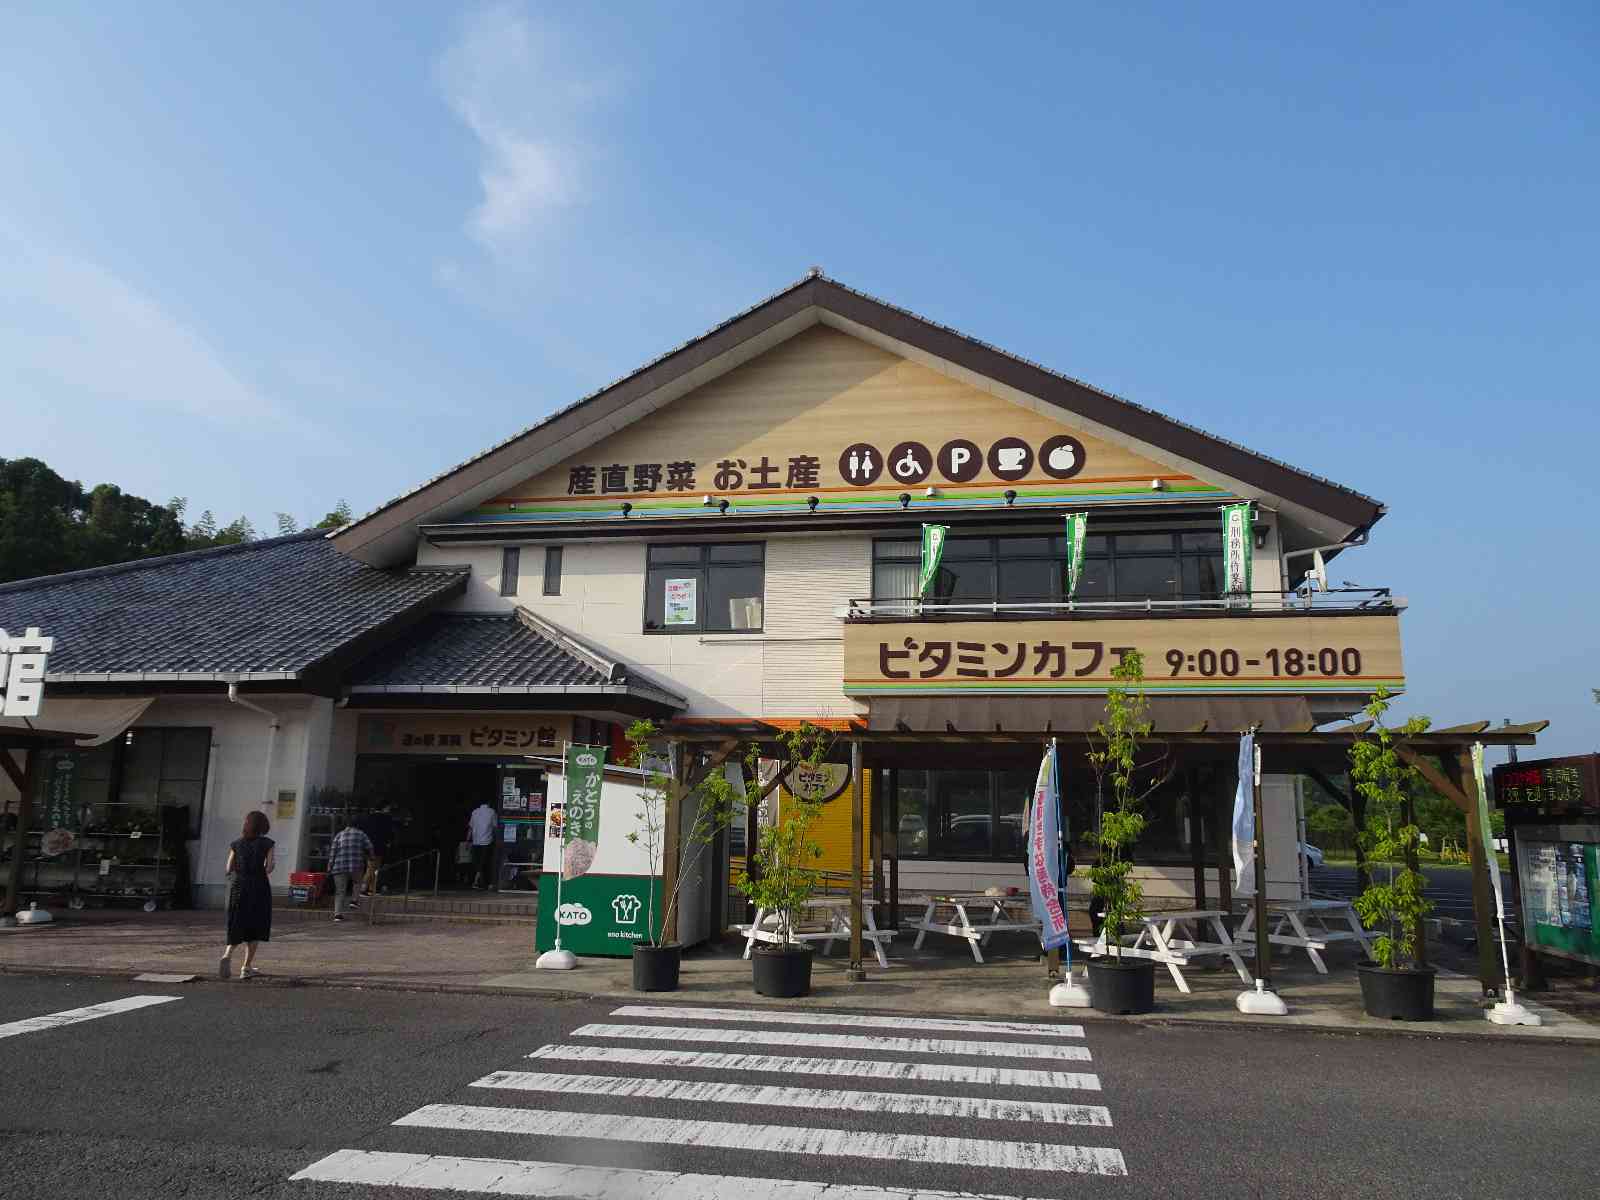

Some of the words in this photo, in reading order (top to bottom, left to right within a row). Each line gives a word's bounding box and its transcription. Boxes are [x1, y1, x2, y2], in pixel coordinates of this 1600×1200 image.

[568, 460, 697, 496] 産直野菜
[714, 454, 821, 491] お土産
[1166, 647, 1362, 677] 9:00-18:00
[469, 725, 557, 748] ビタミン館
[559, 911, 588, 920] KATO
